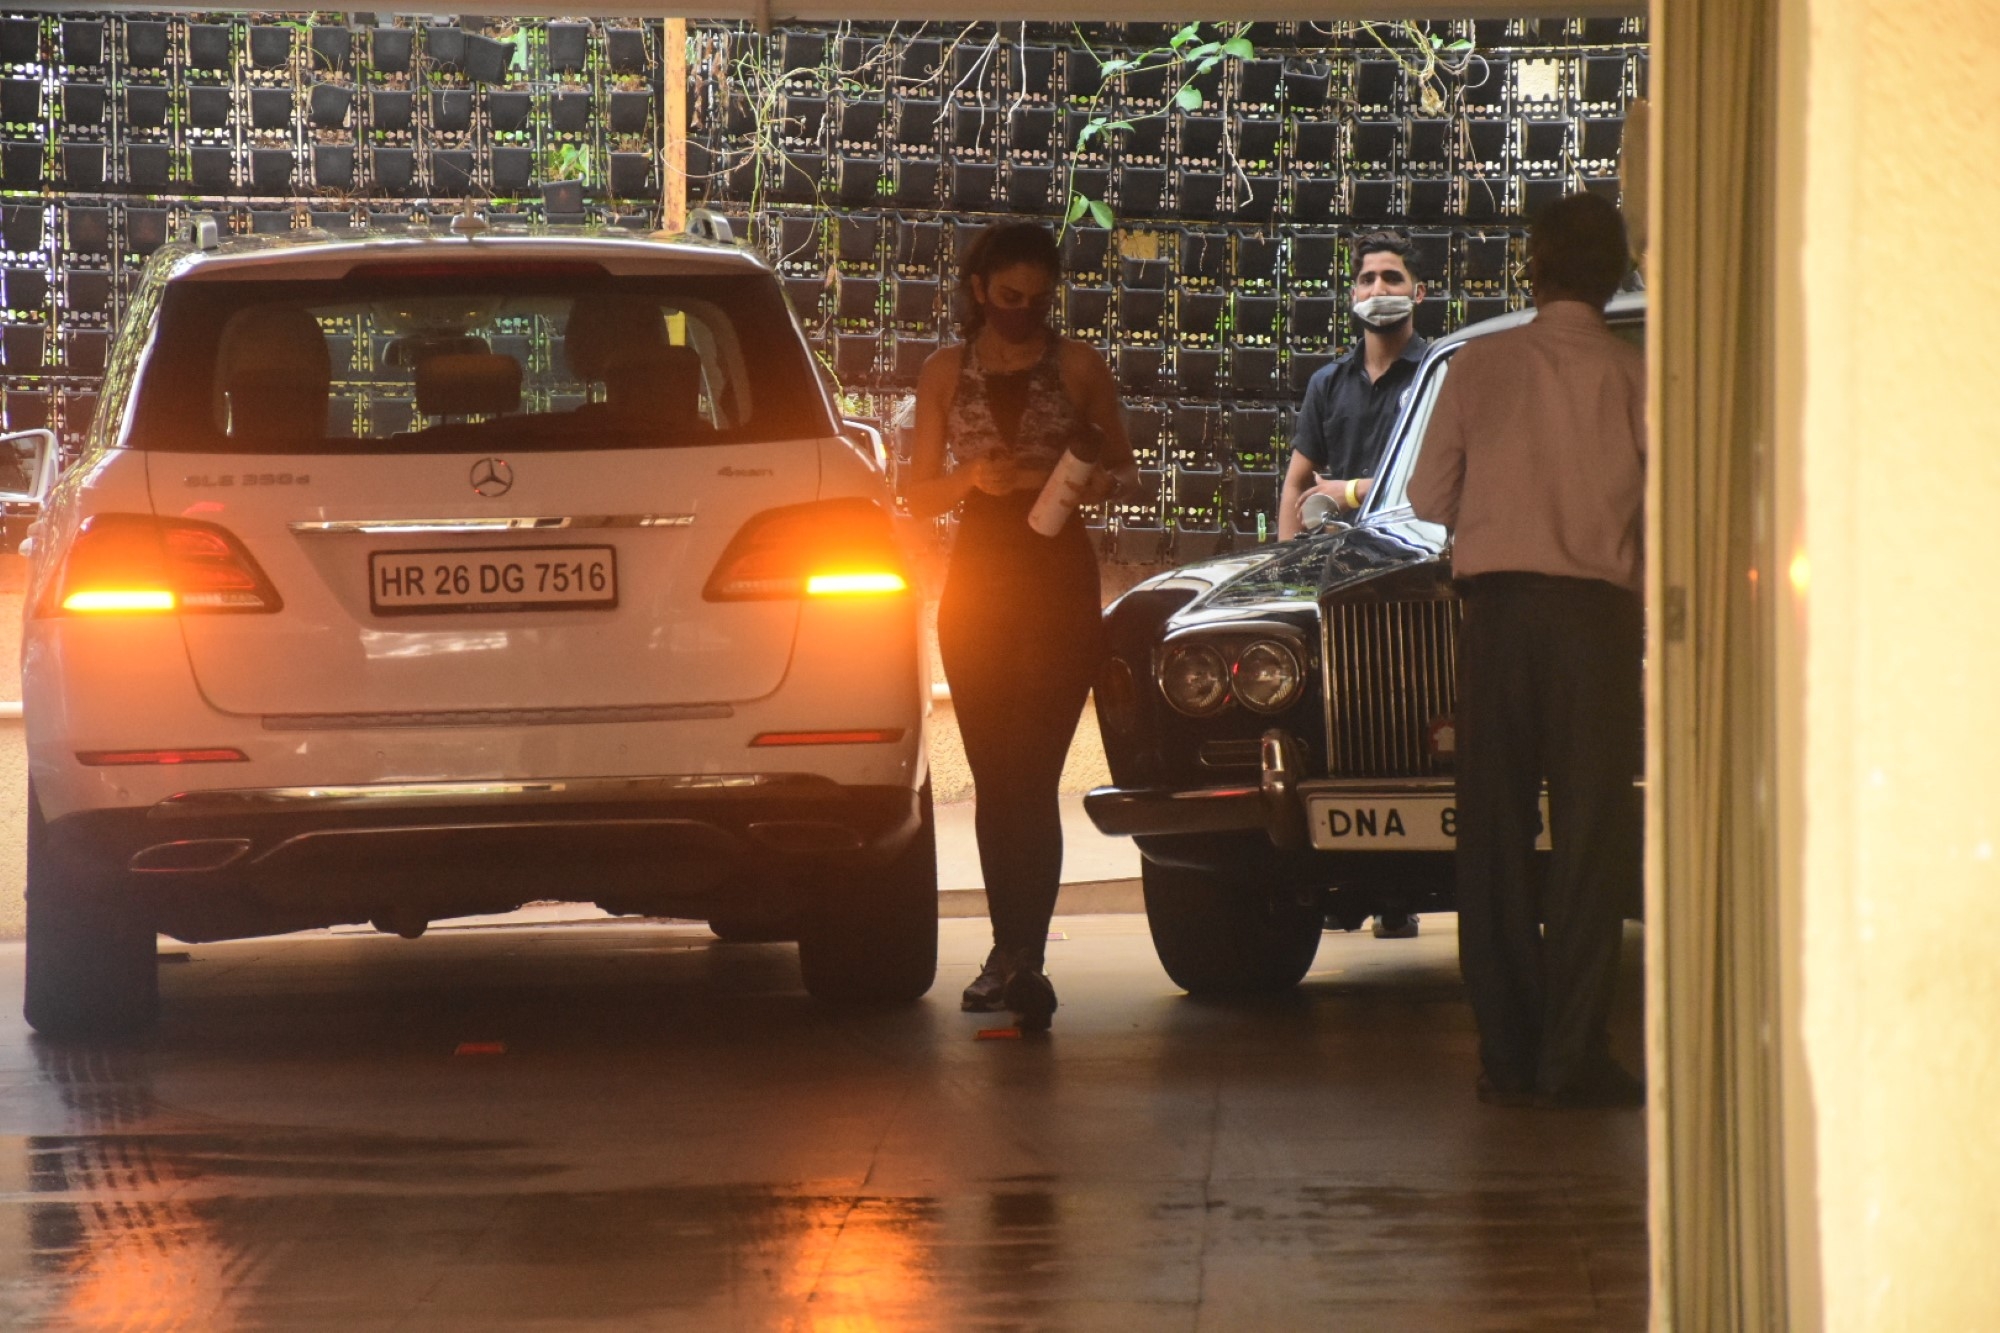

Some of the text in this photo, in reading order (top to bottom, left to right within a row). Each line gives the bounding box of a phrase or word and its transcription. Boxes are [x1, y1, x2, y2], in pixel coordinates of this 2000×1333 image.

[382, 562, 606, 597] HR 26 DG 7516
[1328, 808, 1406, 837] DNA
